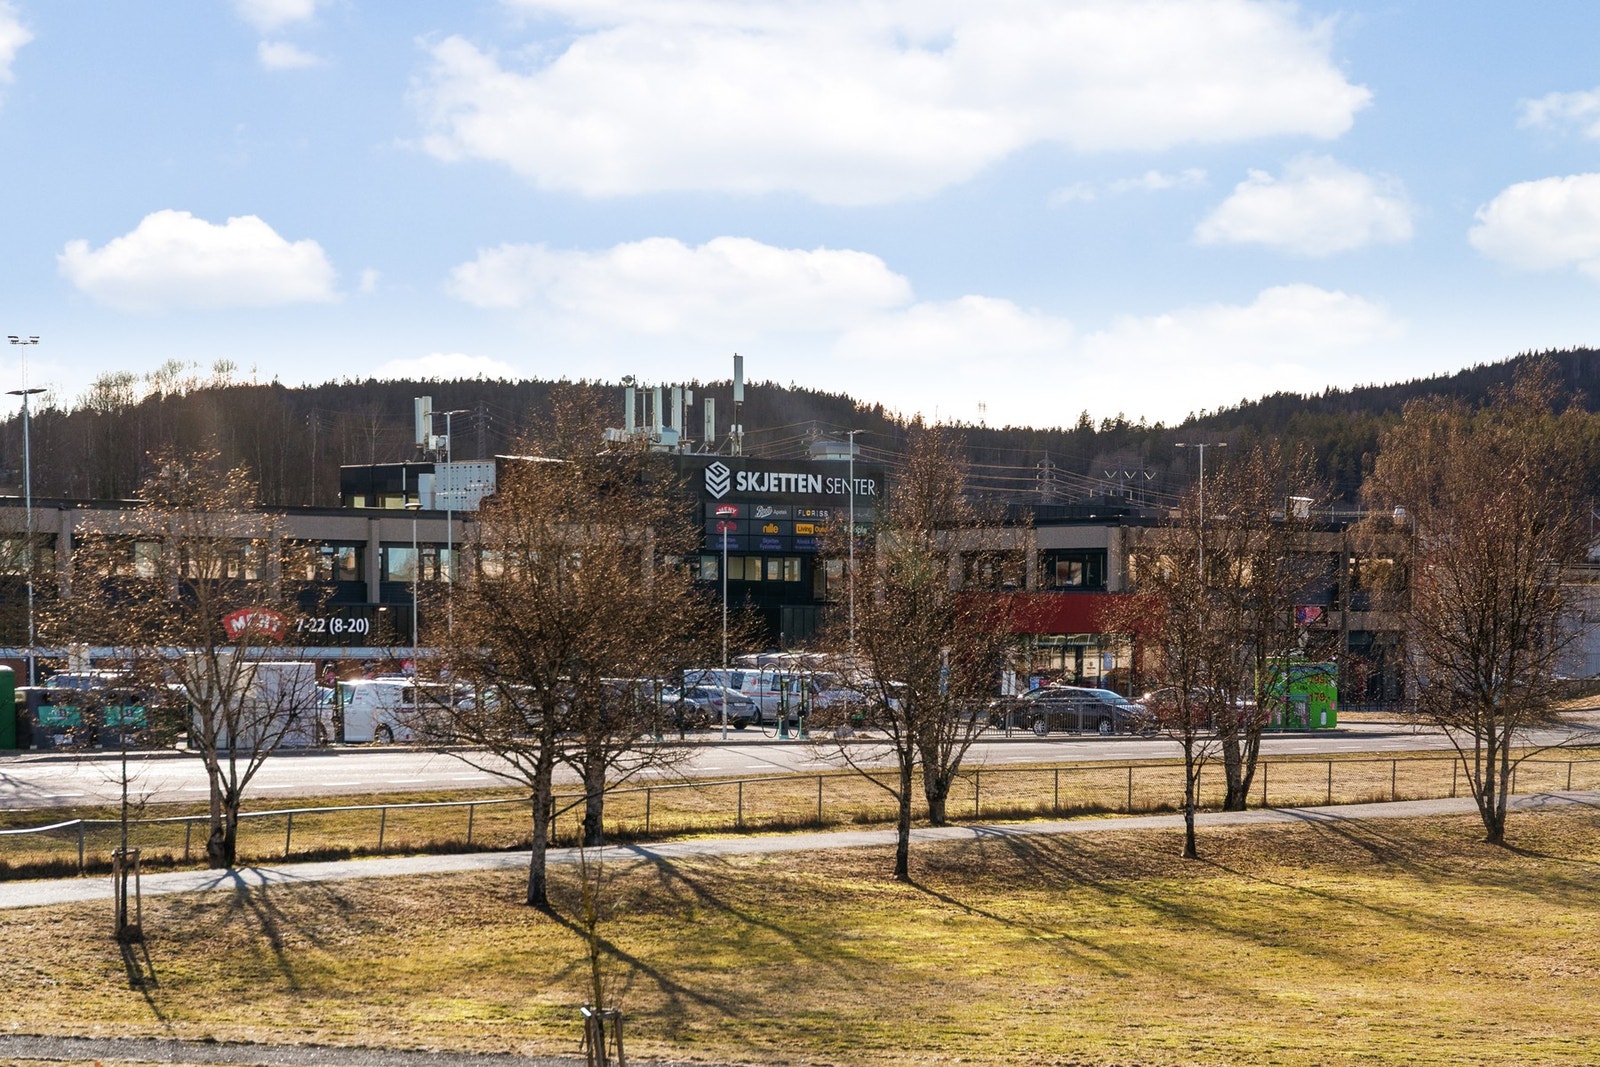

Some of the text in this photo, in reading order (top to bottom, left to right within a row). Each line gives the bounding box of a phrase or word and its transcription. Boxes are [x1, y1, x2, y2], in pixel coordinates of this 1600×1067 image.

[736, 471, 876, 496] SKJETTEN SENTER
[797, 525, 812, 533] Living
[296, 618, 326, 633] 7-22
[329, 617, 370, 635] (8-20)
